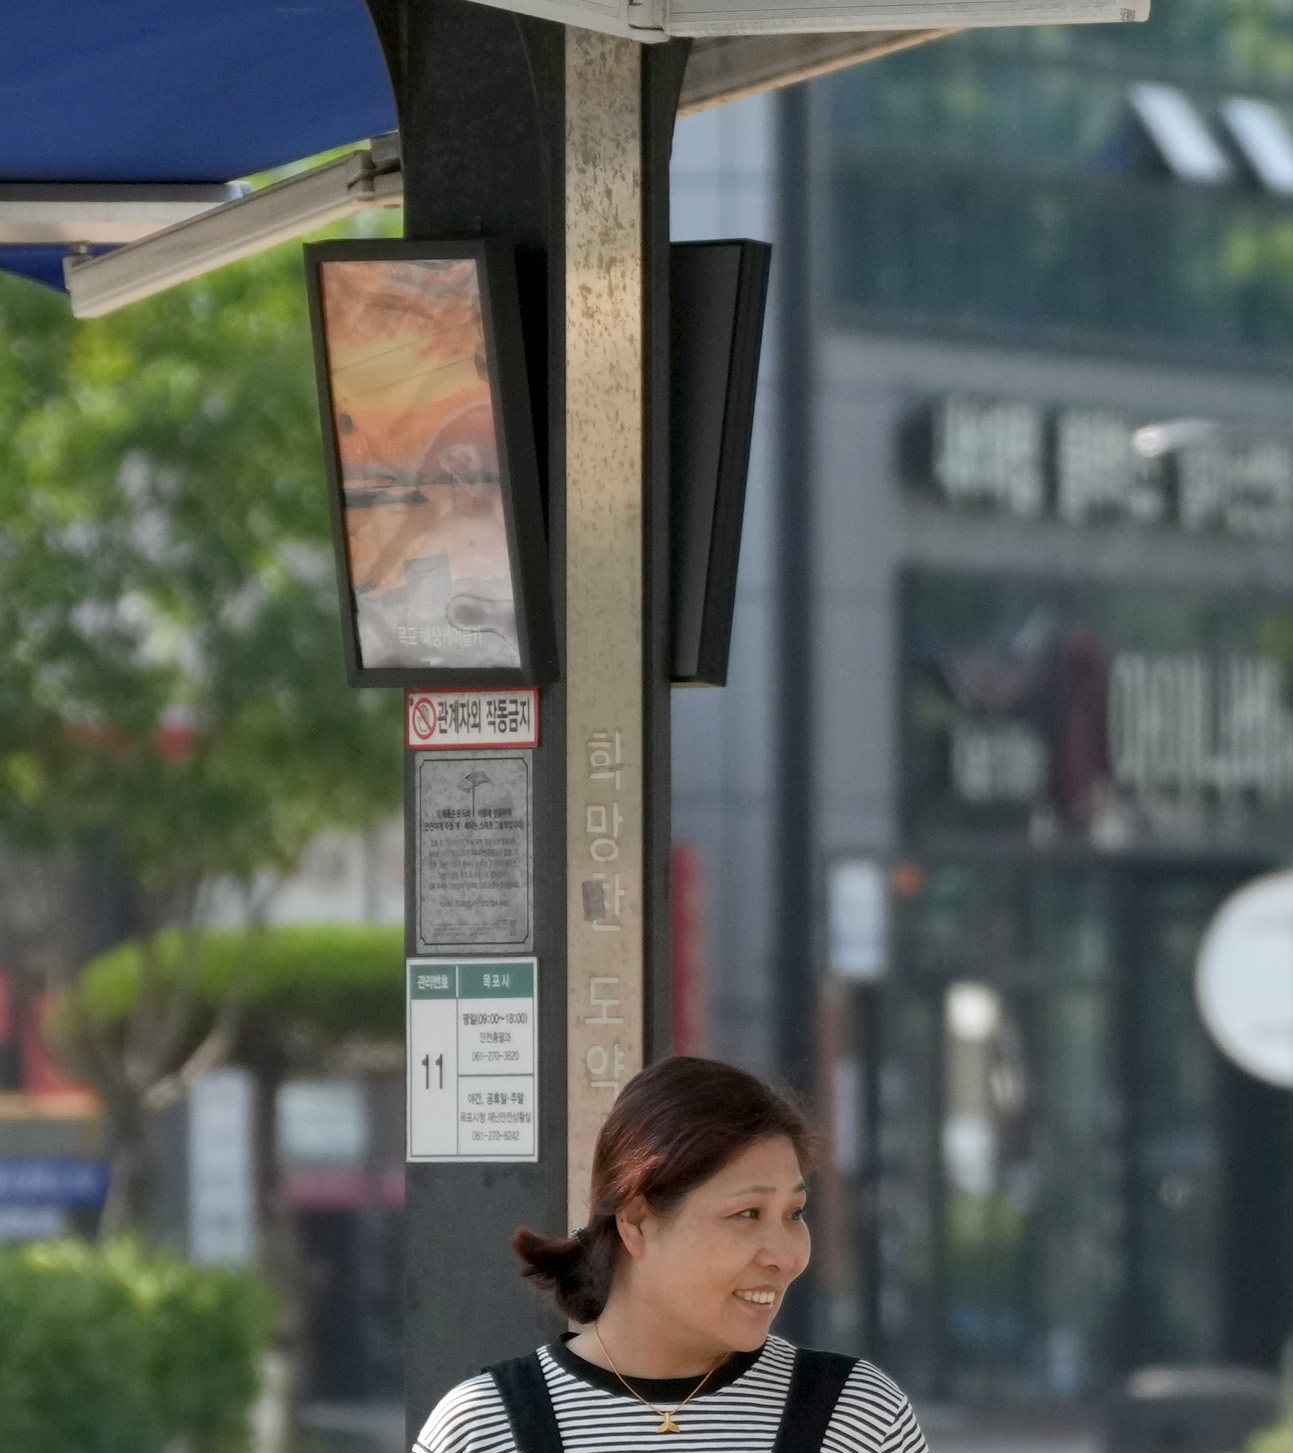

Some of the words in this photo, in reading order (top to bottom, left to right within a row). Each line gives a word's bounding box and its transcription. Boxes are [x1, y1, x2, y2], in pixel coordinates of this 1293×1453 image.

[398, 626, 418, 647] 목포
[437, 699, 482, 735] 관계자외
[486, 697, 530, 734] 작동금지
[417, 975, 449, 990] 관리번호
[483, 974, 510, 988] 목포시
[422, 1053, 443, 1090] 11
[460, 1112, 486, 1124] 목포시청
